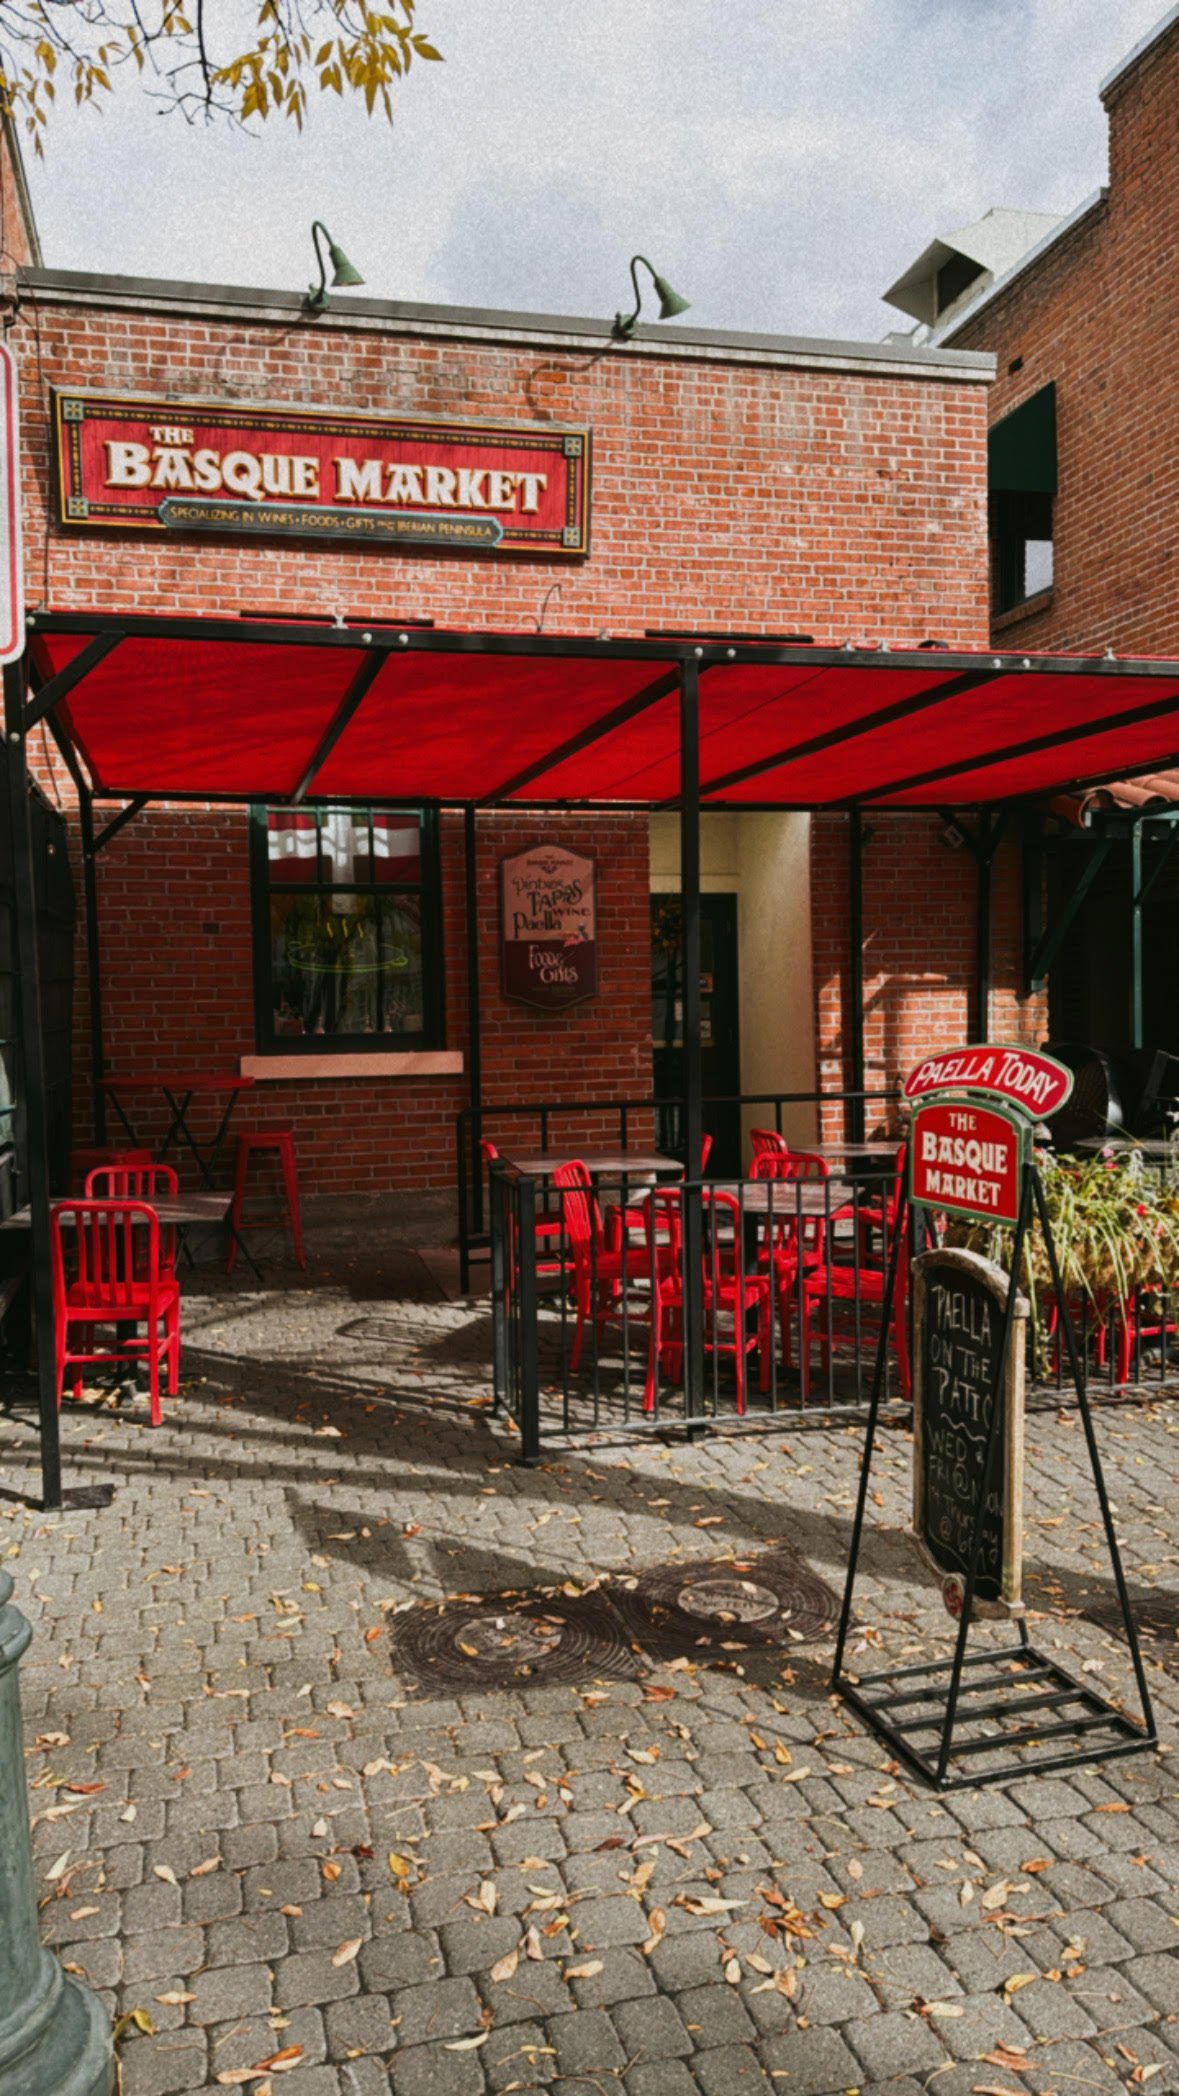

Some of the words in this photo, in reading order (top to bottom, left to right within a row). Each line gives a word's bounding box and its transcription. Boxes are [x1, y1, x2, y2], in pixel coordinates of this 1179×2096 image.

[149, 425, 194, 445] THE
[104, 441, 319, 500] BASQUE
[333, 457, 549, 513] MARKET
[170, 506, 240, 522] SPECIALIZING
[242, 511, 254, 523] IN
[258, 512, 293, 526] WINES
[302, 514, 339, 528] FOODS
[346, 517, 375, 530] GIFTS
[397, 520, 436, 534] IBERIAN
[438, 523, 492, 537] PENINSULA
[513, 909, 562, 939] Paella
[908, 1055, 995, 1094] PAELLA
[993, 1052, 1059, 1105] TODAY
[949, 1111, 977, 1131] THE
[921, 1131, 1008, 1175] BASQUE
[926, 1168, 1001, 1207] MARKET
[931, 1284, 991, 1347] PAELLA
[931, 1333, 954, 1369] ON
[956, 1345, 992, 1384] THE
[926, 1418, 968, 1462] WED
